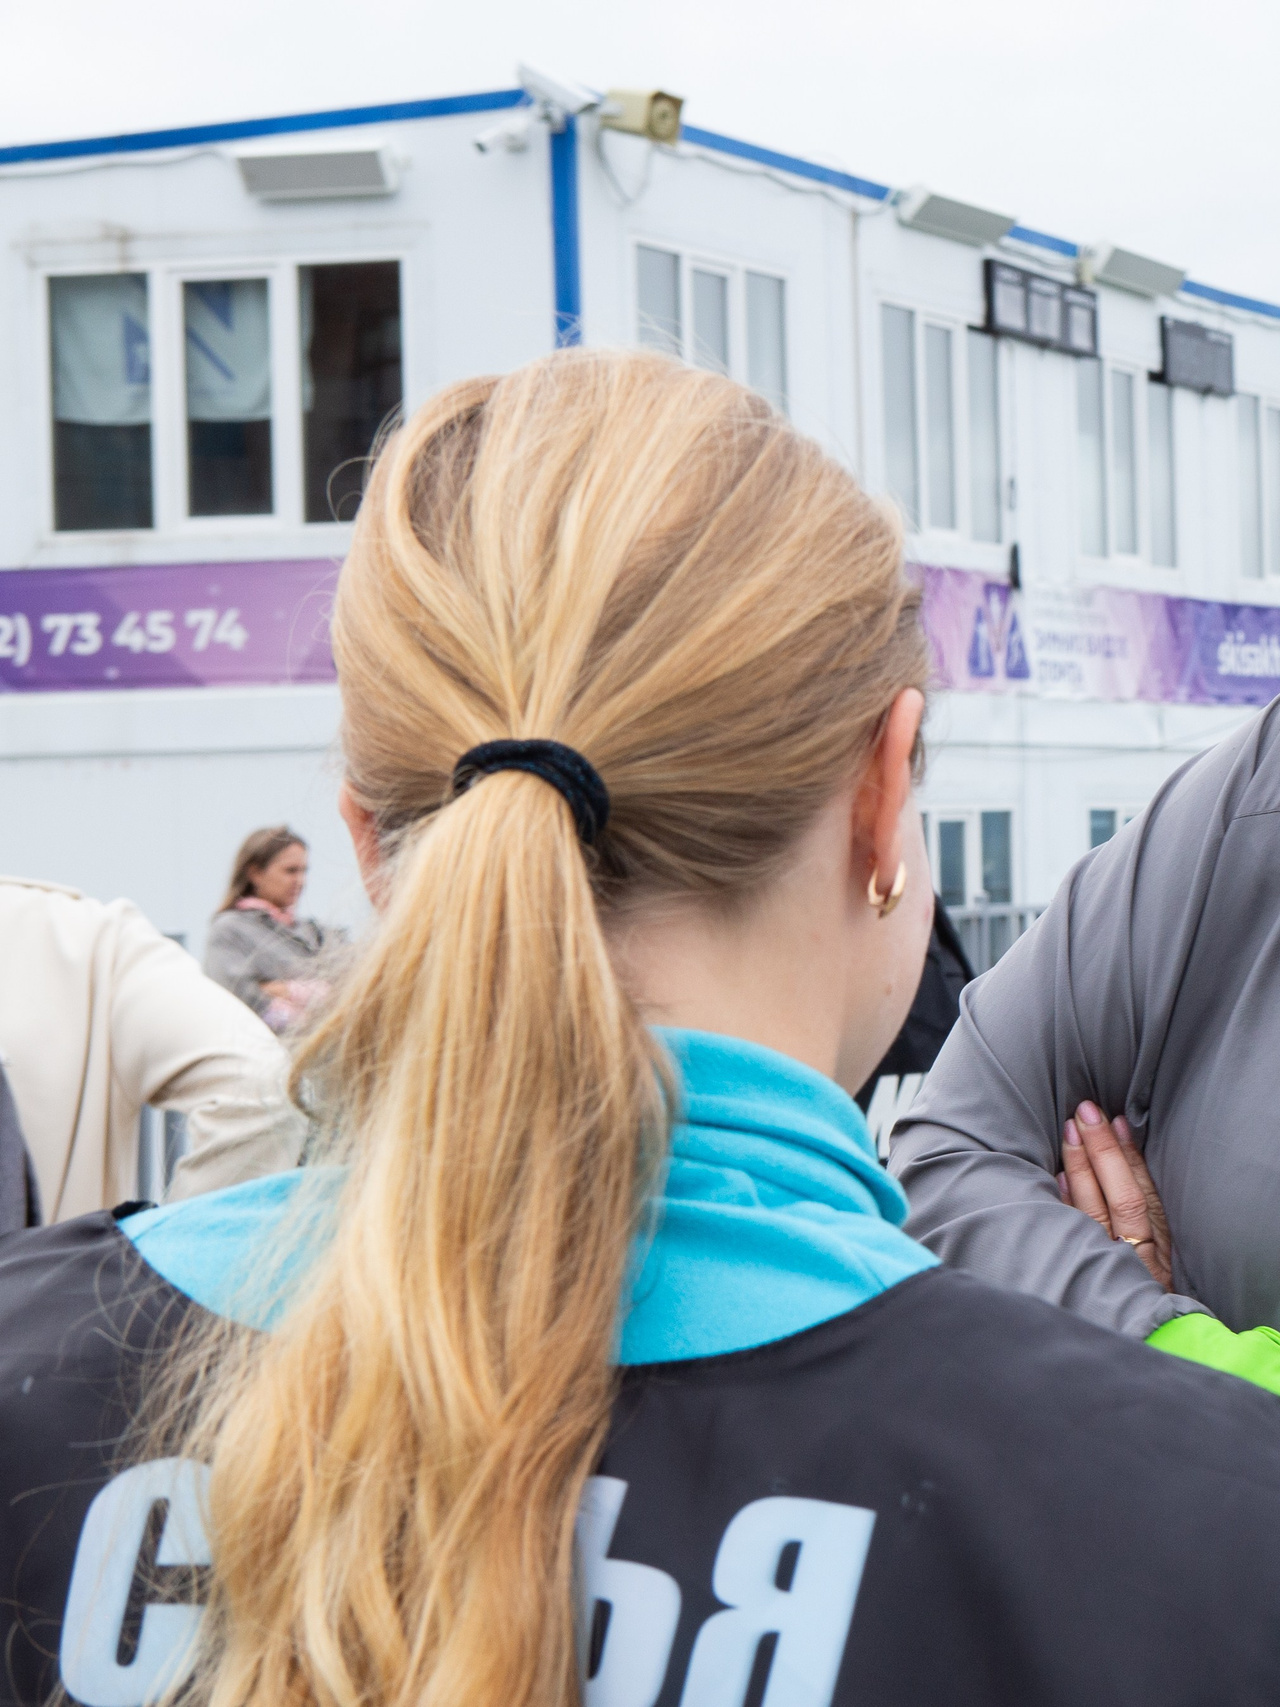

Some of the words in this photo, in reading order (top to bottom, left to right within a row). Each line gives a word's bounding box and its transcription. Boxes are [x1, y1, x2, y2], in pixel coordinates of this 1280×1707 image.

[41, 612, 102, 656] 73
[111, 611, 177, 653] 45
[184, 608, 250, 651] 74
